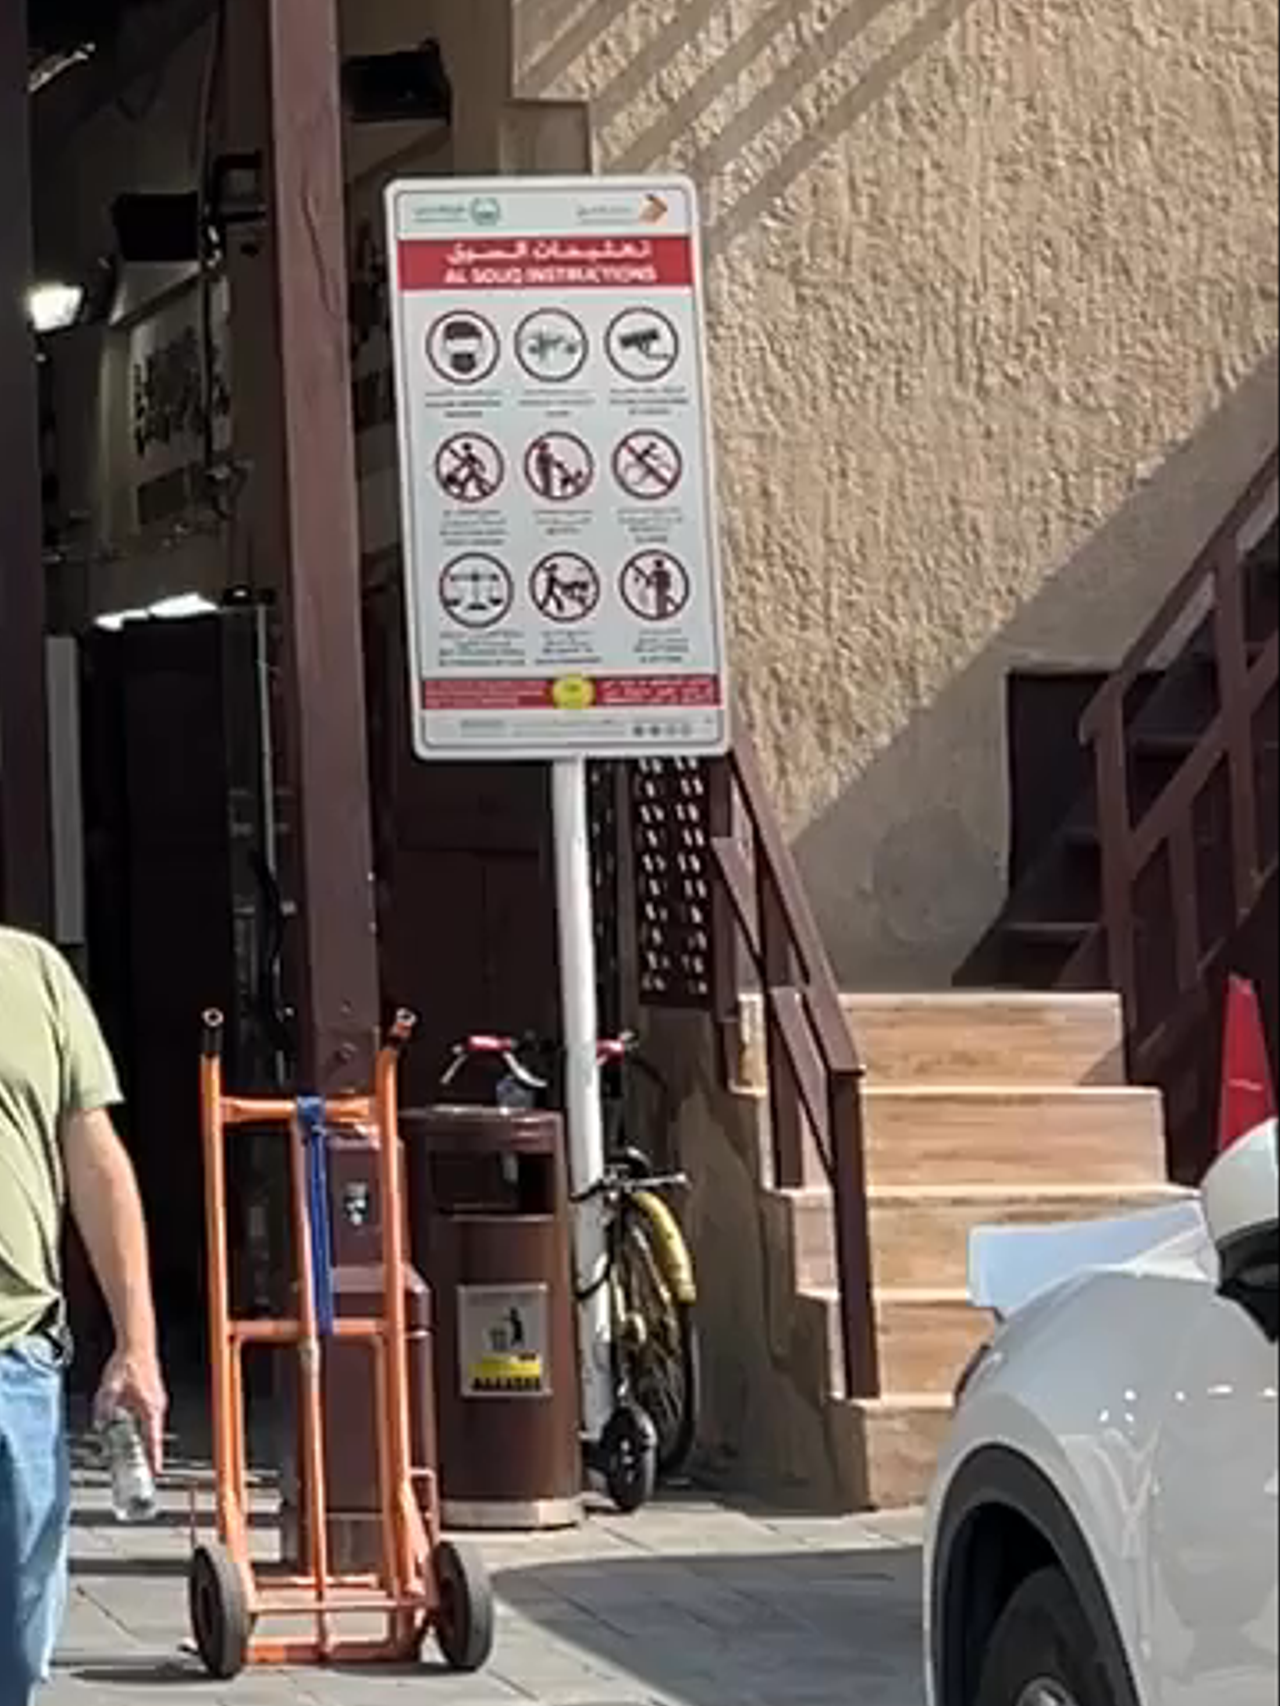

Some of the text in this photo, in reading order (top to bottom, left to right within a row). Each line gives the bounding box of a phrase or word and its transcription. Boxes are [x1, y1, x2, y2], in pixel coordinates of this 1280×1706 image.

[443, 263, 658, 284] AL SOUQ INSTRUCTIONS
